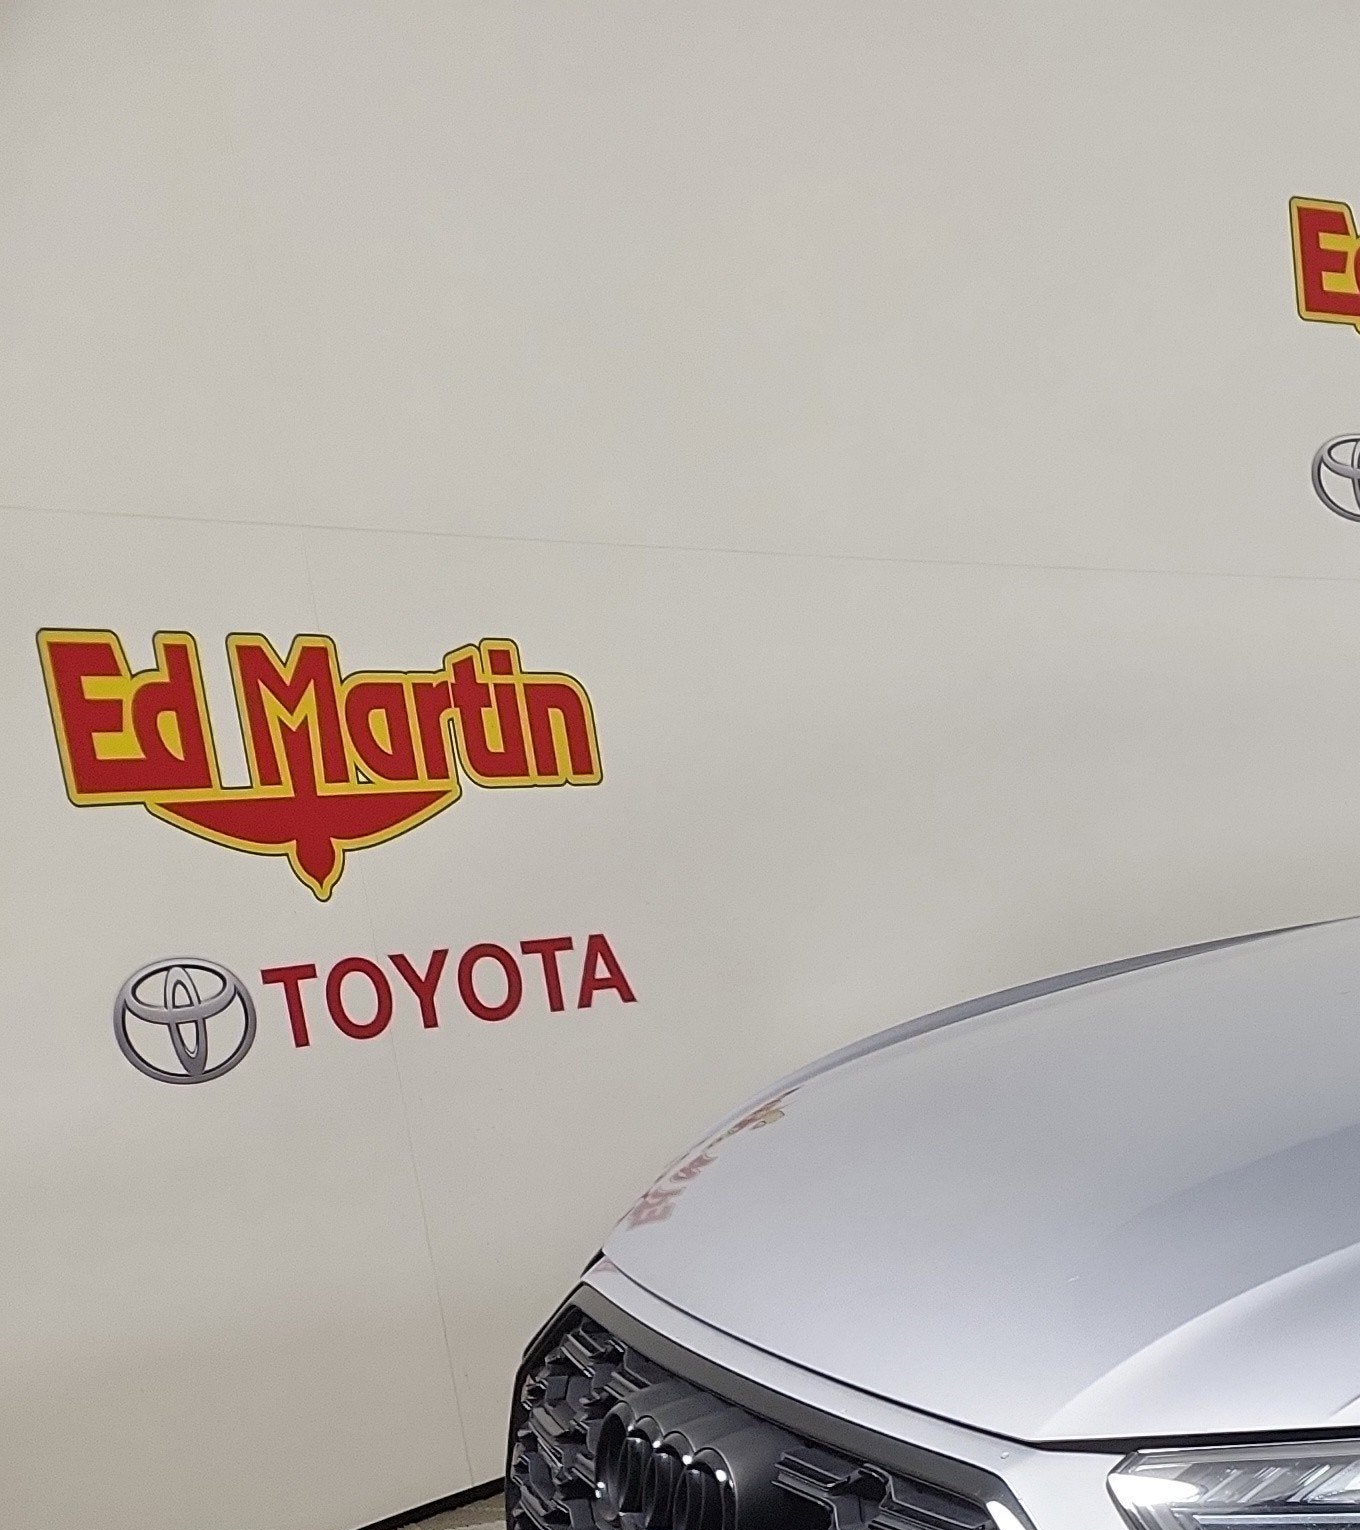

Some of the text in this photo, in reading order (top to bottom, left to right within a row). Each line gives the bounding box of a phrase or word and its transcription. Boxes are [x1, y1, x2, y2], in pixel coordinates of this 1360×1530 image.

[46, 640, 596, 794] Ed Martin
[261, 933, 637, 1048] TOYOTA
